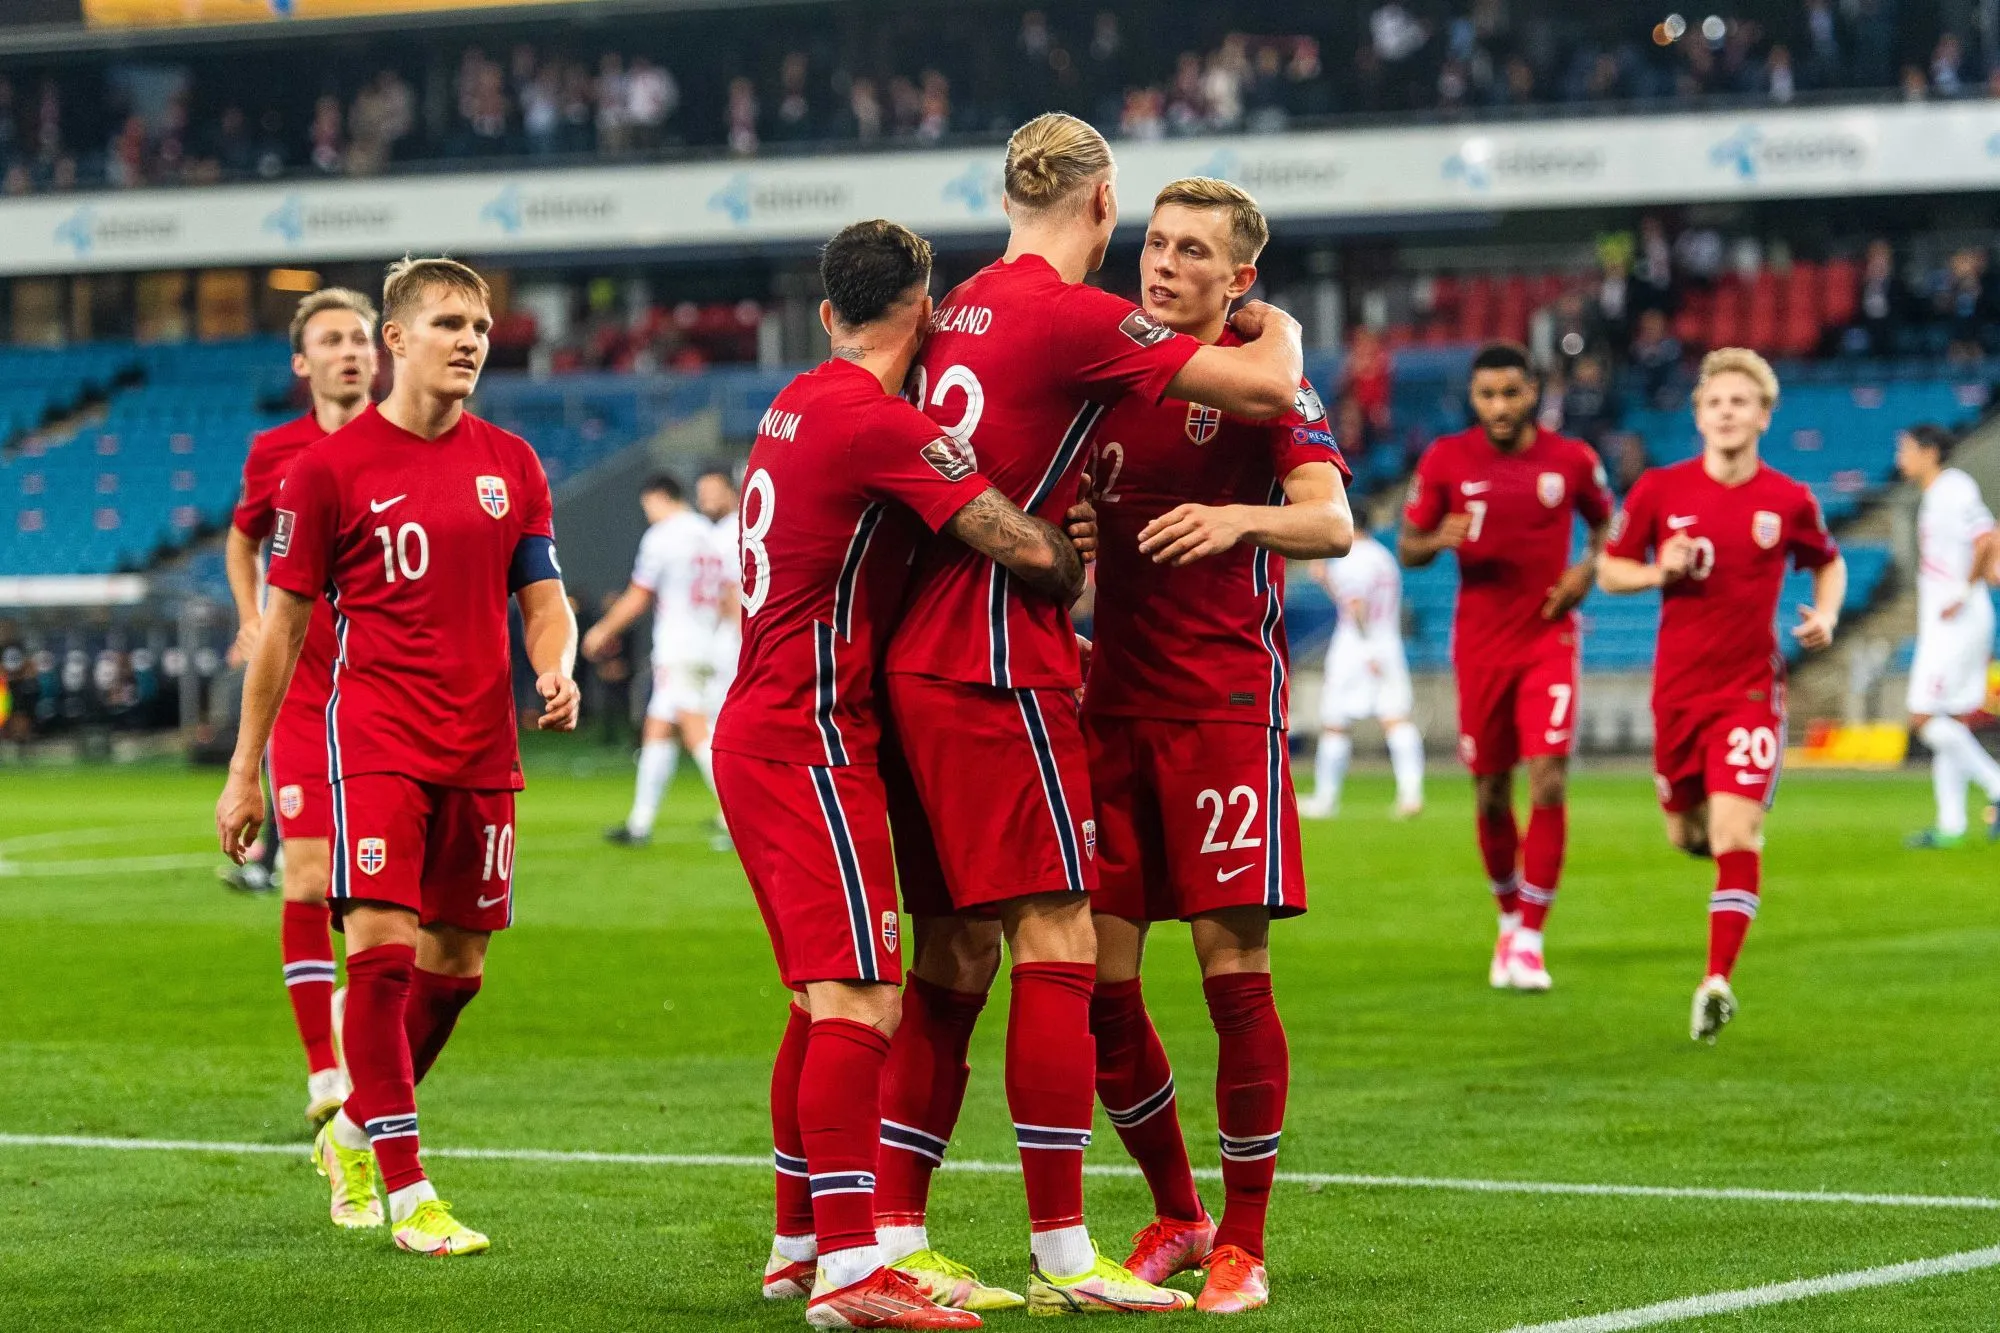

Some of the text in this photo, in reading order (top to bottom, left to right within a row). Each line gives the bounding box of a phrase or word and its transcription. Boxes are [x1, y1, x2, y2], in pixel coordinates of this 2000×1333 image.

[758, 407, 802, 442] NUM
[738, 465, 776, 618] 8
[1464, 500, 1488, 542] 7
[375, 522, 429, 583] 10
[1548, 683, 1572, 727] 7
[1725, 726, 1776, 770] 20
[1196, 784, 1262, 854] 22
[481, 823, 513, 881] 10
